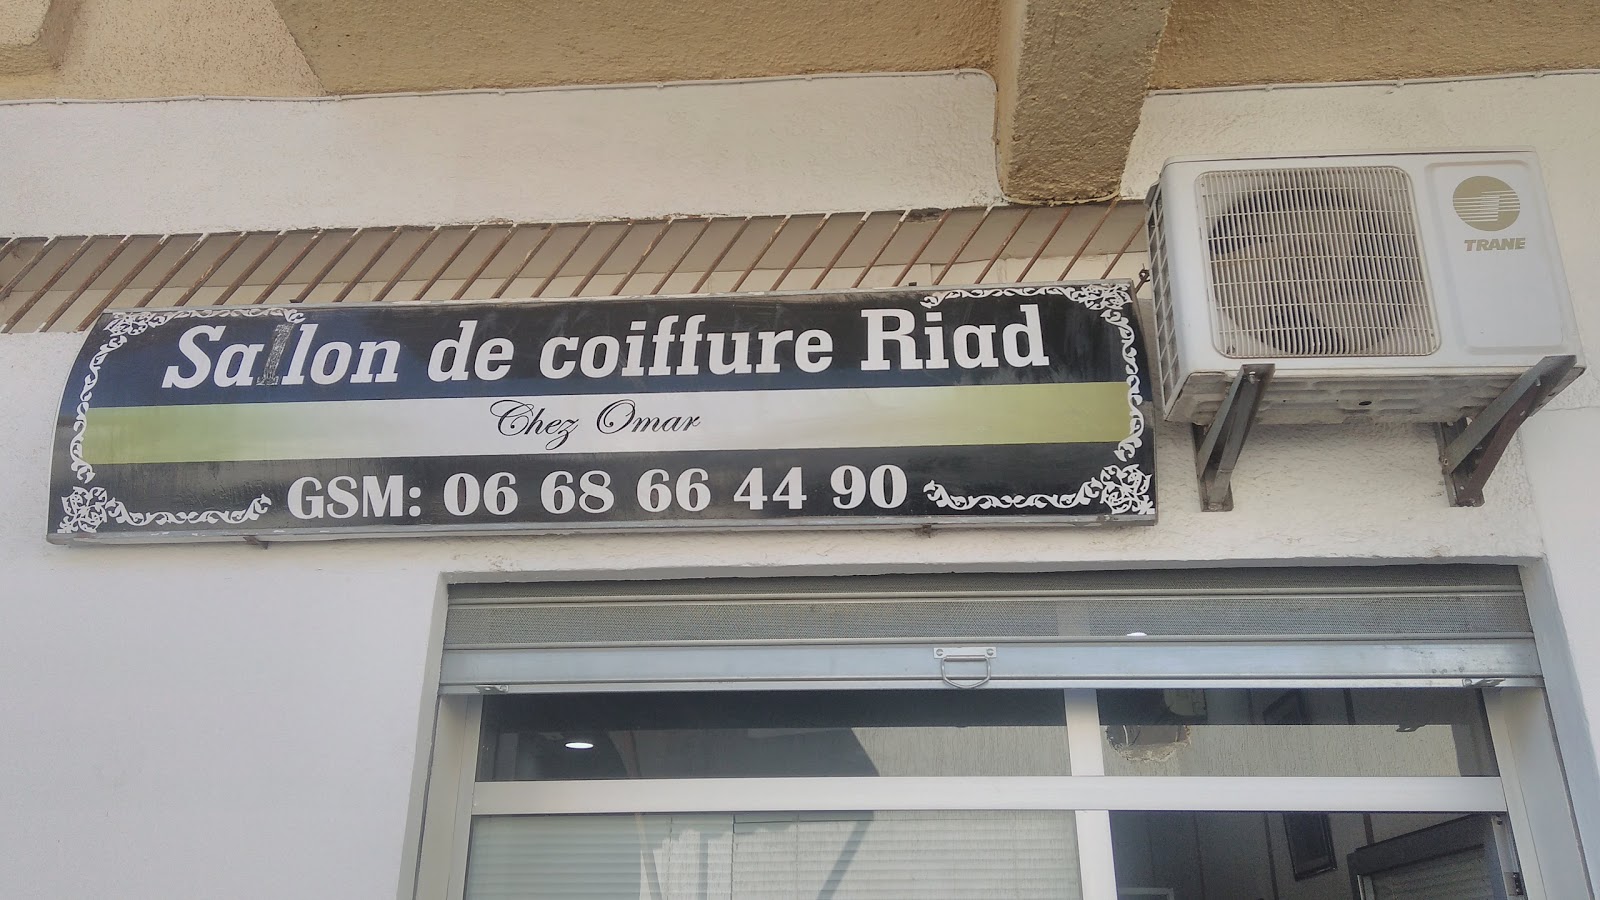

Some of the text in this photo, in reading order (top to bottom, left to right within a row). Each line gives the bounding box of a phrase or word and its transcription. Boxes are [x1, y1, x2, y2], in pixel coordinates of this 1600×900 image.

[1464, 238, 1526, 251] TRANE
[427, 320, 515, 384] de
[539, 314, 834, 377] coiffure
[860, 304, 1050, 372] Riad
[489, 397, 701, 450] Chez Omar
[287, 464, 908, 520] GSM: 06 68 66 44 90
